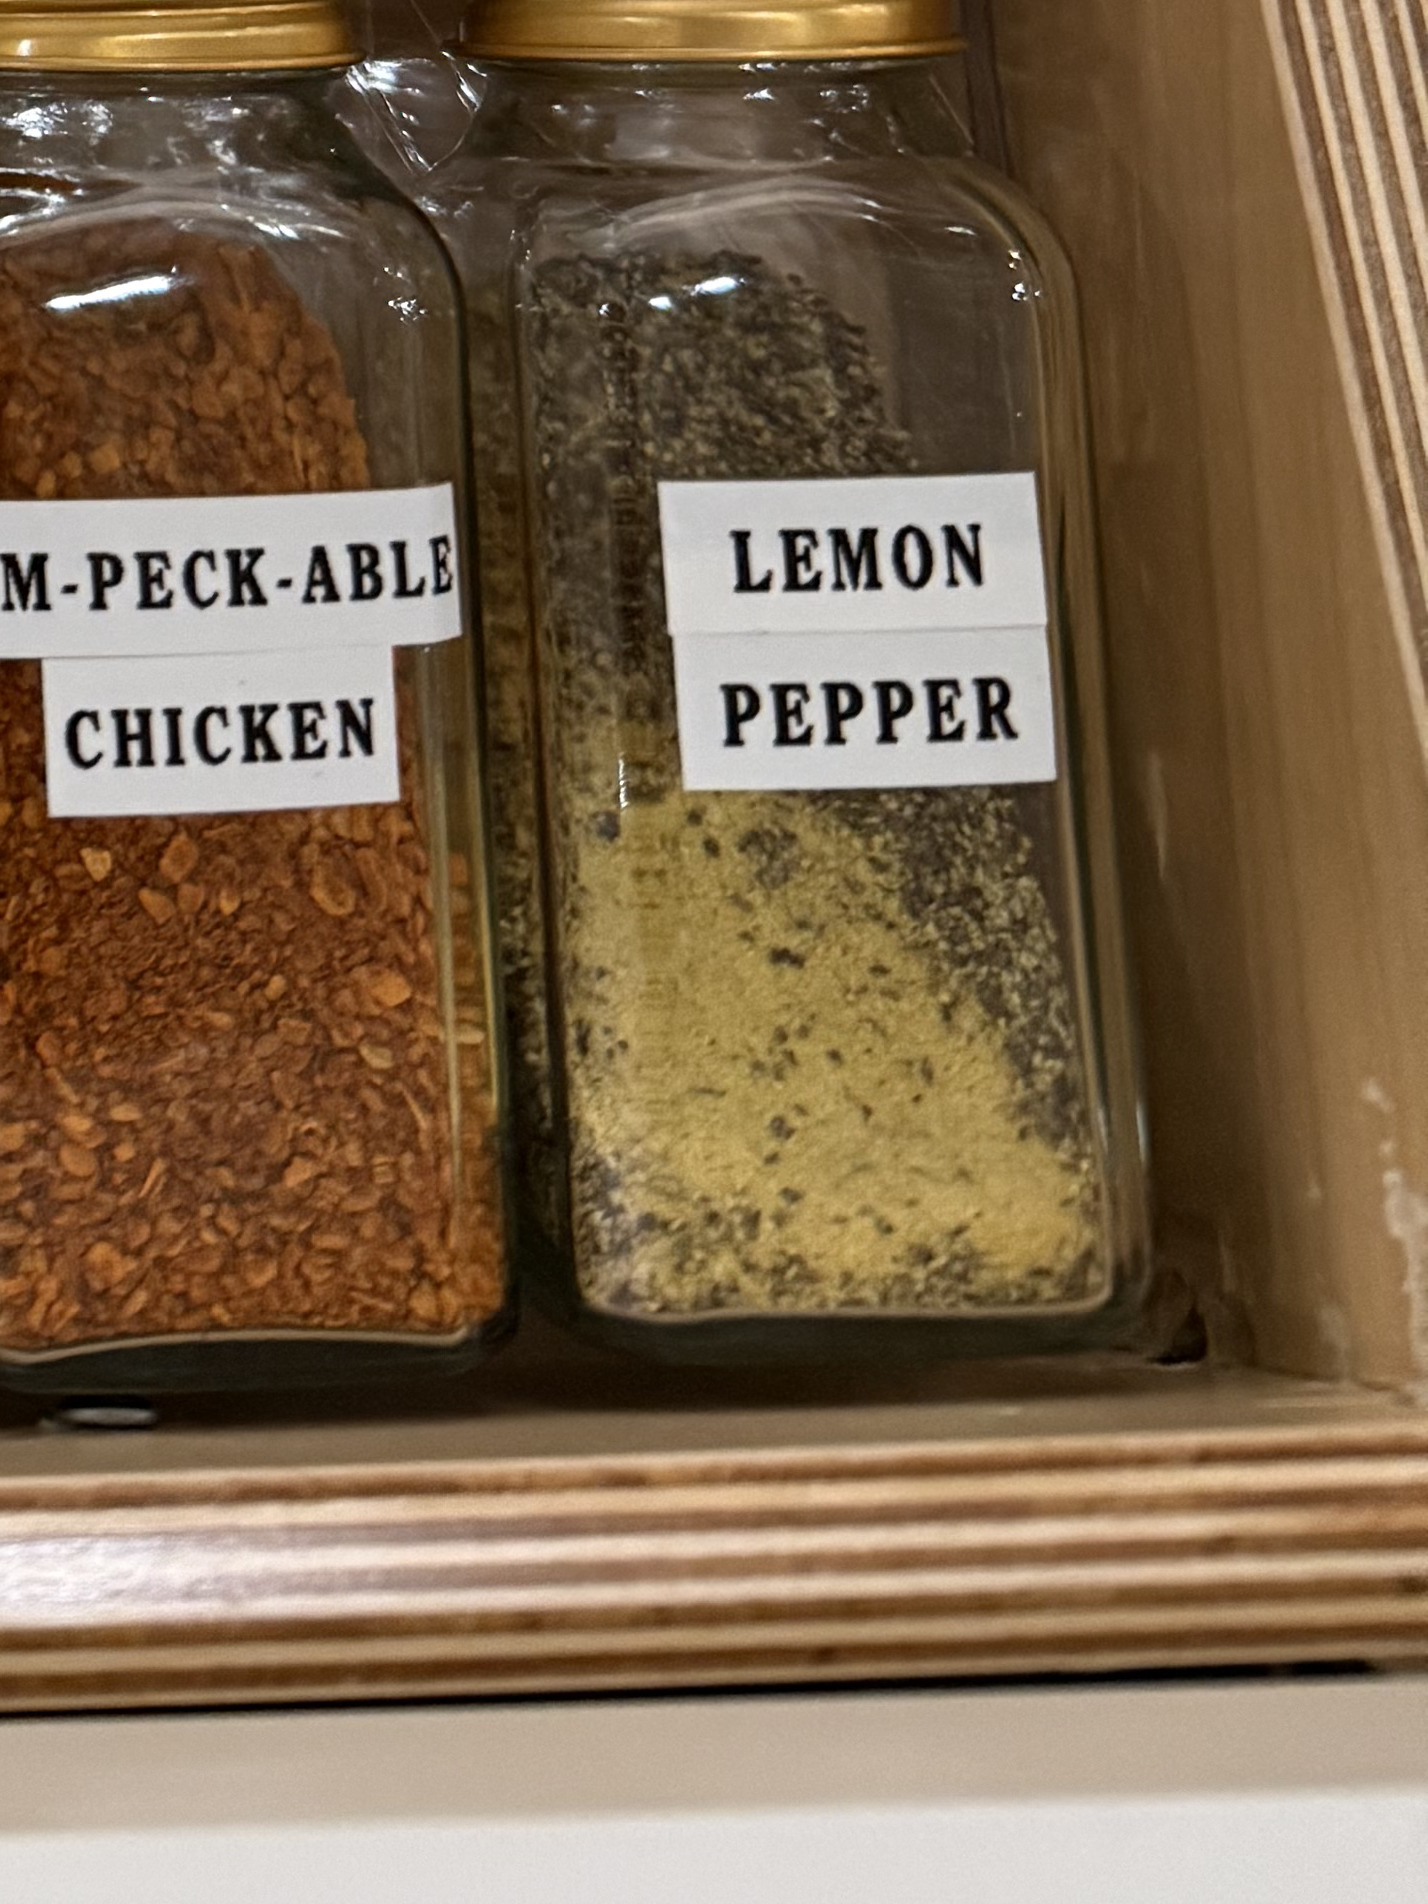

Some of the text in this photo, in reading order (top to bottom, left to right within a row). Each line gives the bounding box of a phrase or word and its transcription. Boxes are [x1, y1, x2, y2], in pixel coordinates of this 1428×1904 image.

[729, 523, 983, 593] LEMON
[65, 698, 374, 770] CHICKEN
[720, 676, 1018, 747] PEPPER
